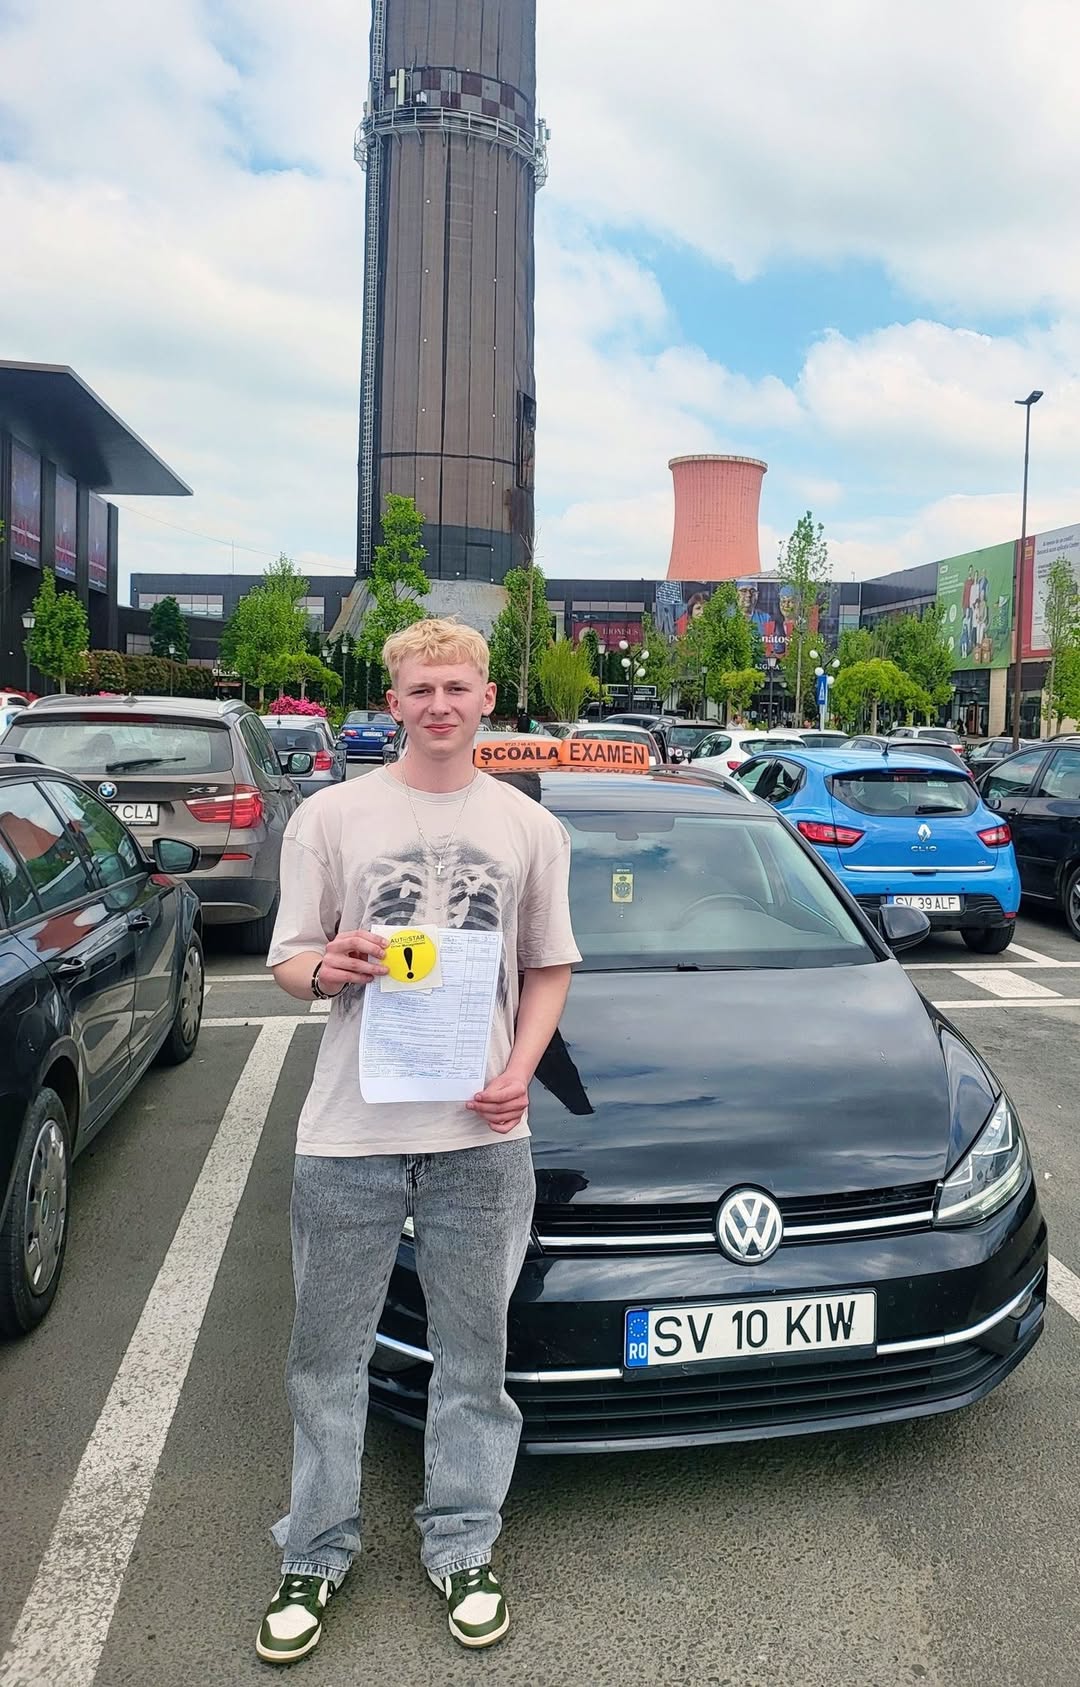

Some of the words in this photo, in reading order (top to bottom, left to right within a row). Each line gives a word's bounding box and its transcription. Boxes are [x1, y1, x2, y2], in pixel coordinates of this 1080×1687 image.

[569, 743, 645, 765] EXAMEN
[122, 804, 154, 820] CLA
[918, 897, 932, 910] 39
[654, 1312, 714, 1357] SV
[732, 1308, 768, 1349] 10
[786, 1300, 856, 1346] KIW
[629, 1342, 648, 1360] RO
